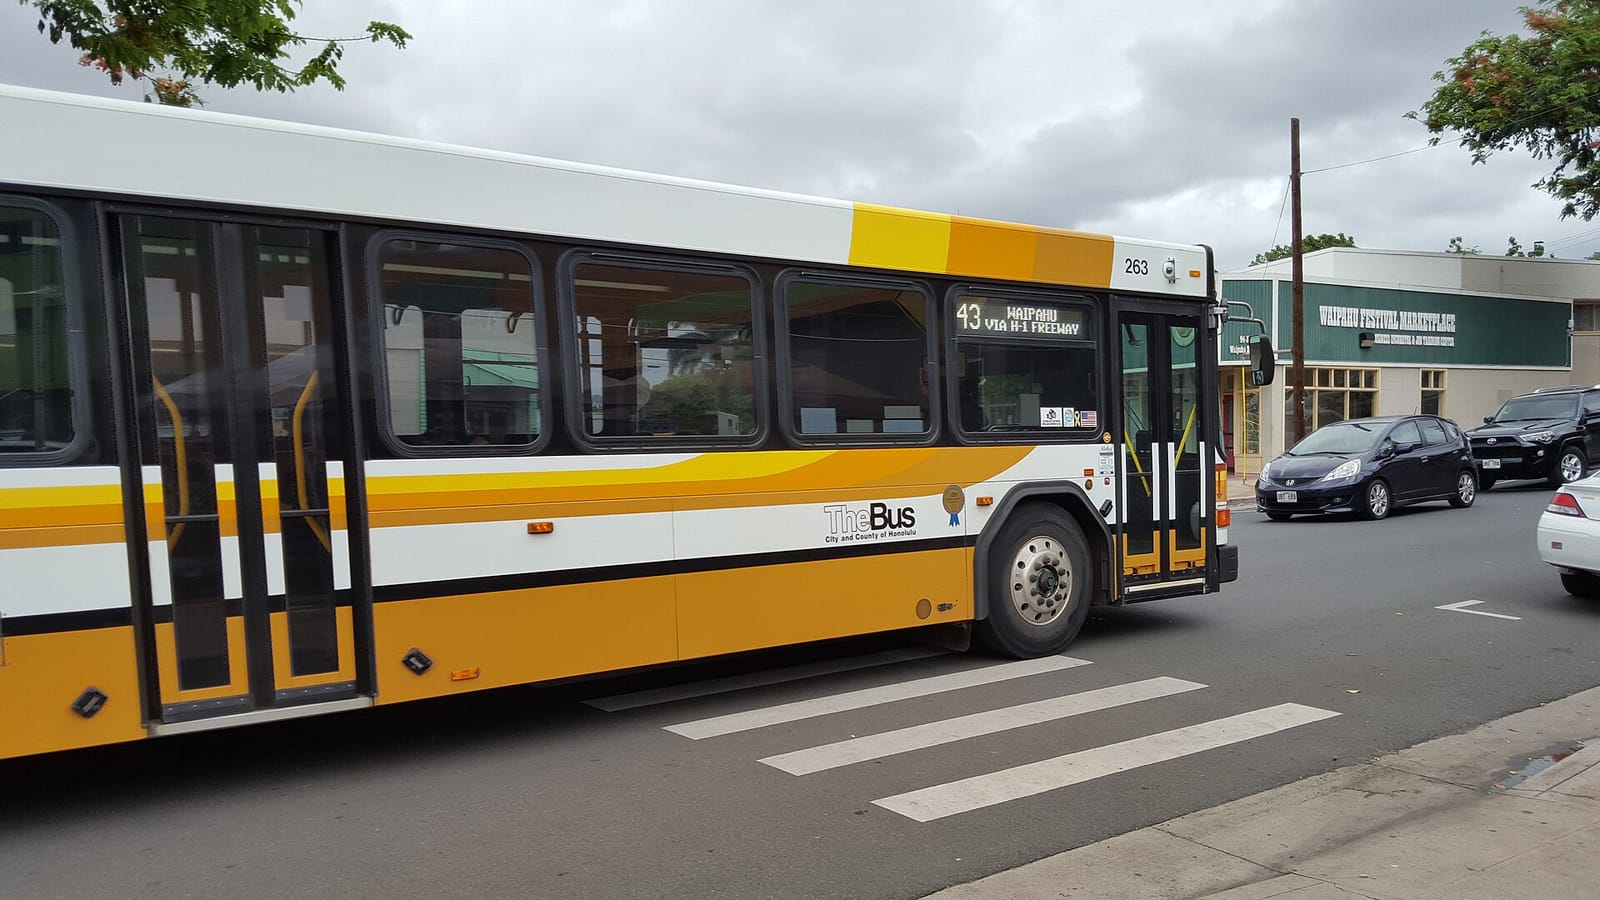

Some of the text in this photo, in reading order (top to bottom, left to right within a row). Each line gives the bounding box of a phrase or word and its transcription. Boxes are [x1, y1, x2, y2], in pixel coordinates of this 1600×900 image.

[1125, 258, 1148, 275] 263
[956, 303, 981, 330] 43
[1006, 306, 1058, 322] WAIPAHU
[1319, 305, 1456, 333] WAIPAHU FESTIVAL MARKETPLACE
[984, 318, 1079, 335] VIA H-1 FREEWAY
[823, 502, 916, 534] TheBus
[825, 535, 839, 543] City
[855, 533, 879, 541] County
[888, 529, 917, 538] Honolulu
